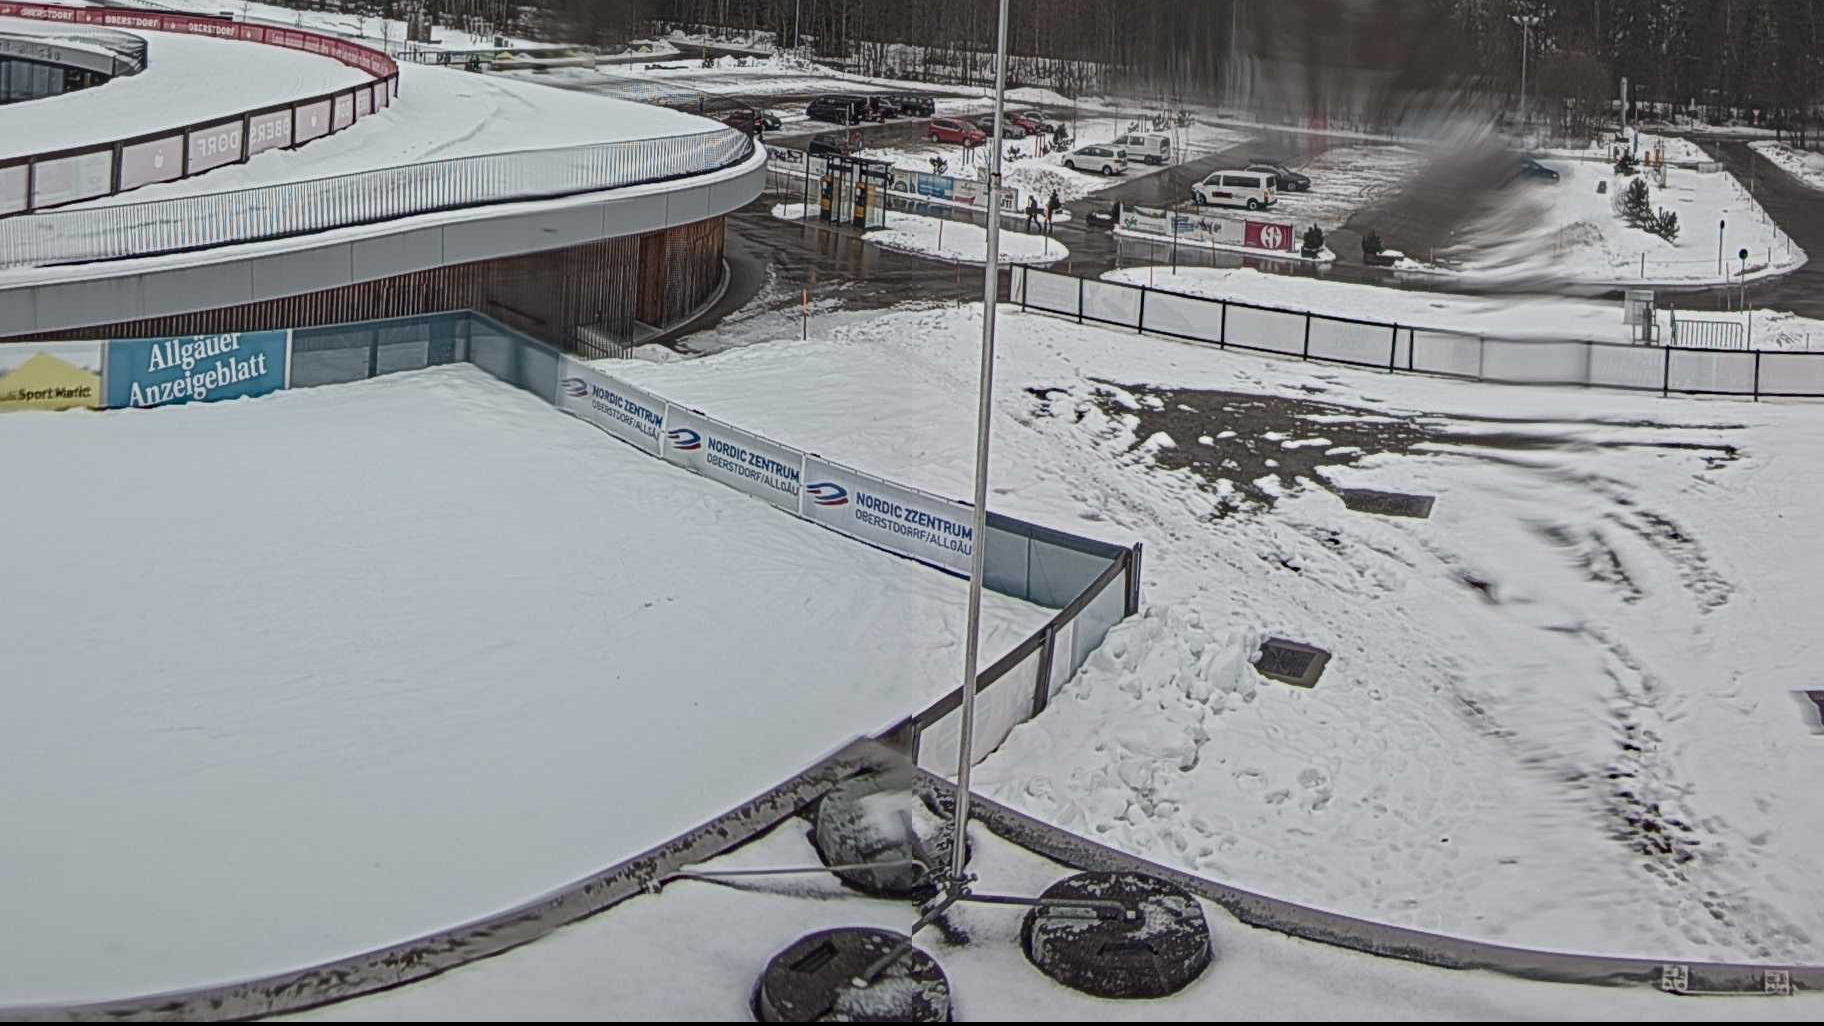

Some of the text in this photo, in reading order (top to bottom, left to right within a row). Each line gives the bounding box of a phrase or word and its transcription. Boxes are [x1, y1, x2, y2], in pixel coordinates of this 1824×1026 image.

[105, 14, 158, 28] OBERSTDORF
[188, 23, 236, 36] OBERSTDORF
[147, 332, 241, 372] Allgäuer
[129, 352, 268, 407] Anzeigeblatt
[592, 384, 664, 429] NORDIC ZENTRUM
[706, 453, 800, 496] OBERSTDORF/ALLGÄU
[707, 437, 800, 484] NORDIC ZENTRUM
[856, 491, 903, 519] NORDIC
